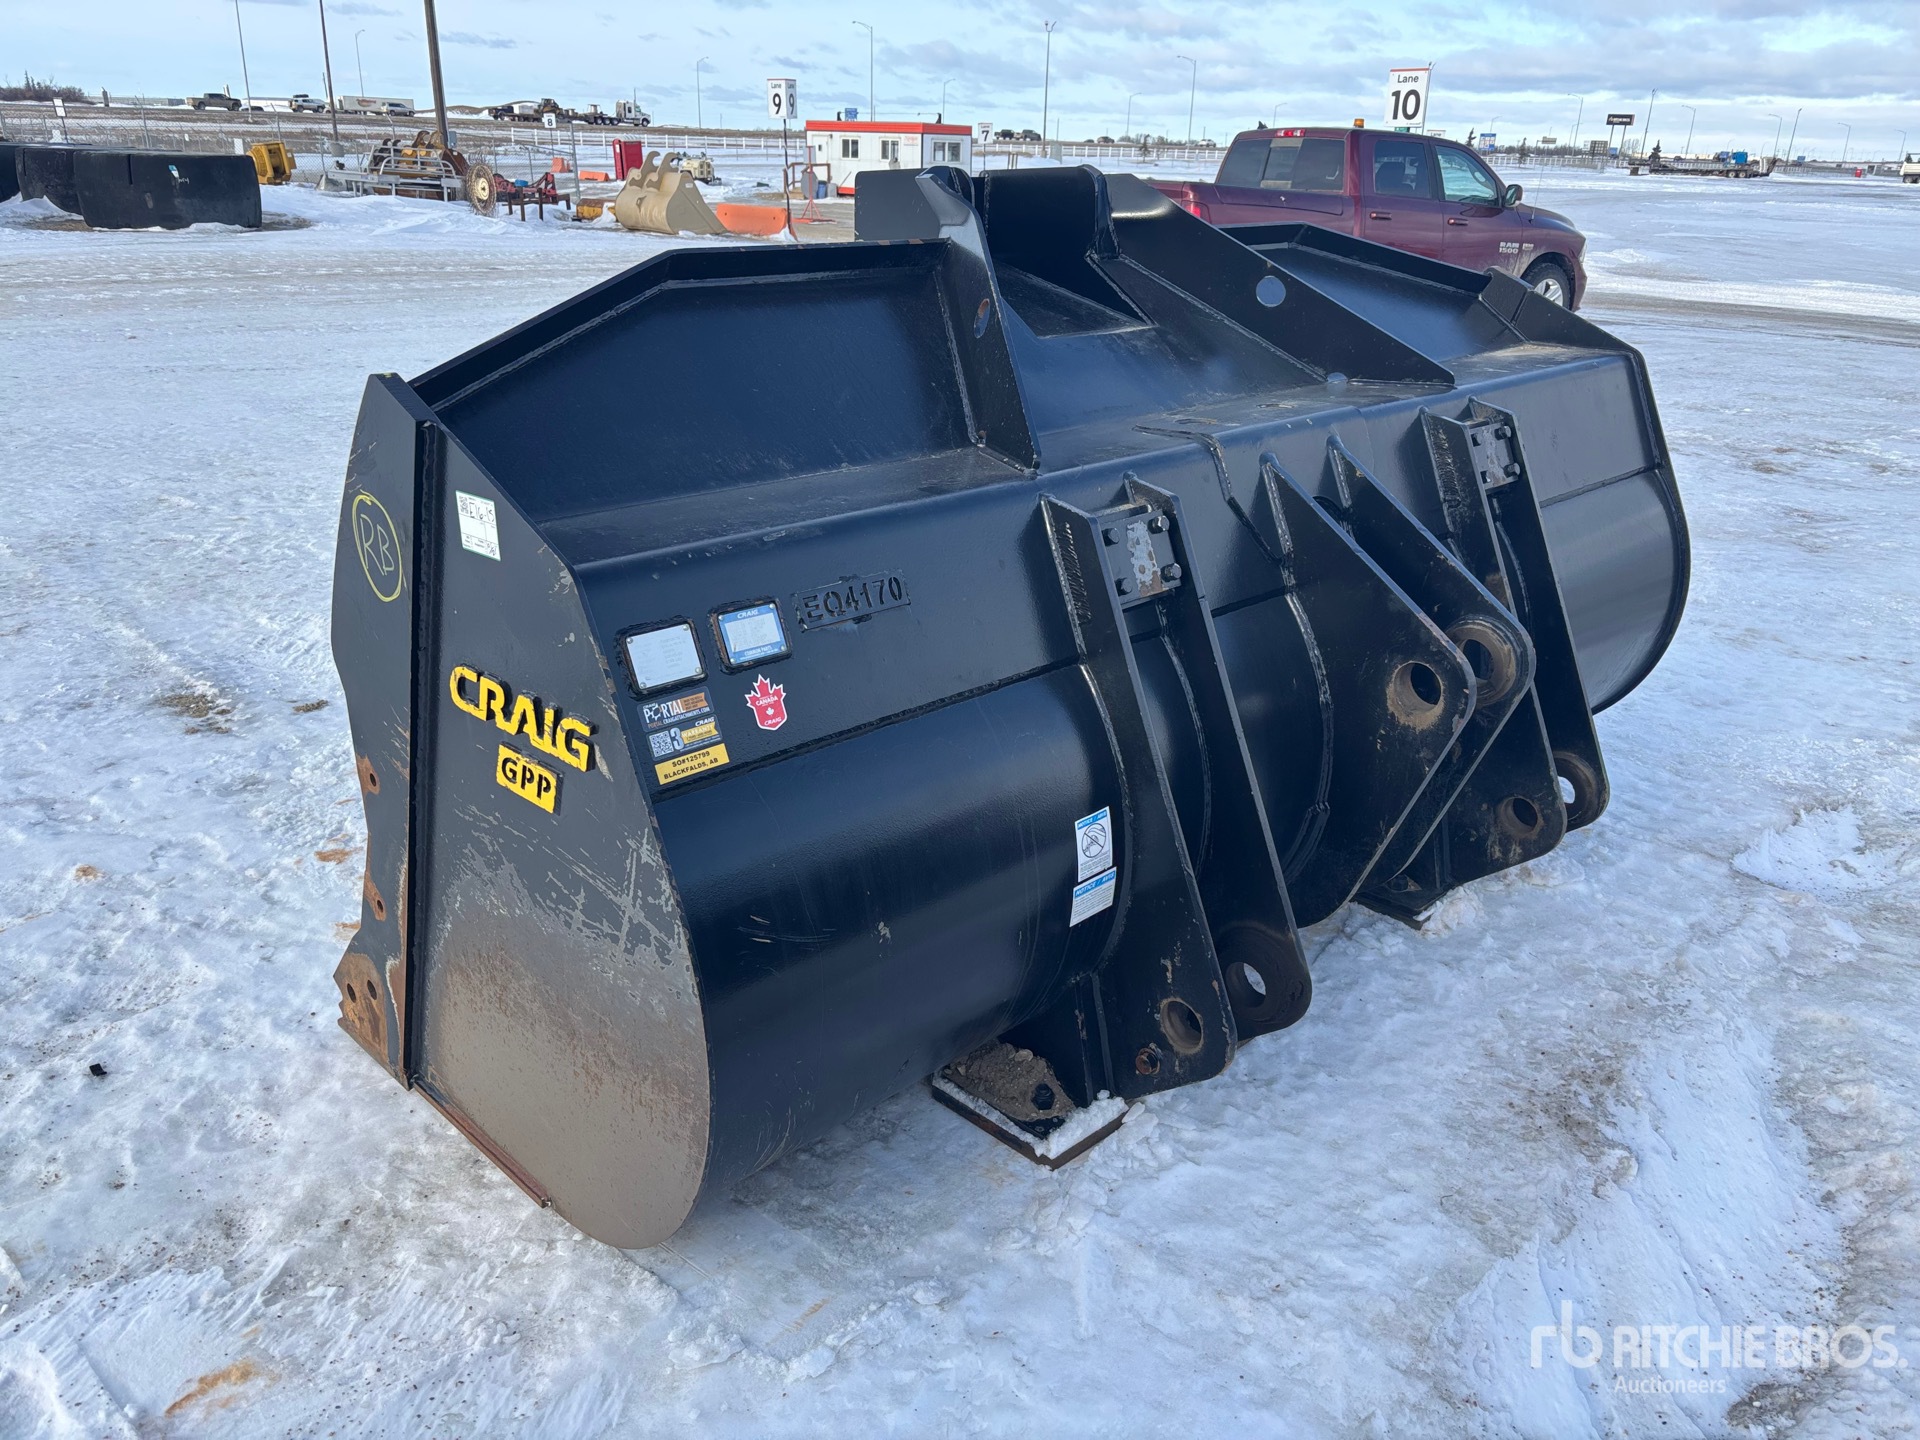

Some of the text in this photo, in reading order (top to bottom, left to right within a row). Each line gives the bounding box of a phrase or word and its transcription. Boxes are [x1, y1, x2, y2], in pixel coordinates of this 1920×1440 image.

[1397, 74, 1419, 83] Lane
[772, 92, 782, 115] 9
[788, 92, 795, 115] 9
[1391, 89, 1421, 120] 10
[547, 118, 553, 127] 8
[981, 130, 990, 142] 7
[360, 513, 395, 576] RB
[802, 576, 903, 623] EQ4170
[737, 609, 759, 619] CRAIG
[643, 698, 686, 724] PORTAL
[755, 695, 779, 706] CANADA
[449, 664, 594, 772] CRAIG
[695, 717, 715, 726] CRAIG
[764, 716, 782, 726] CRAIG
[670, 727, 685, 750] 3
[663, 757, 719, 779] BLACKFALDS, AB
[672, 750, 710, 767] SO#125799
[501, 757, 551, 800] GPP
[1075, 882, 1097, 896] NOTICE
[1101, 873, 1115, 883] AVIS
